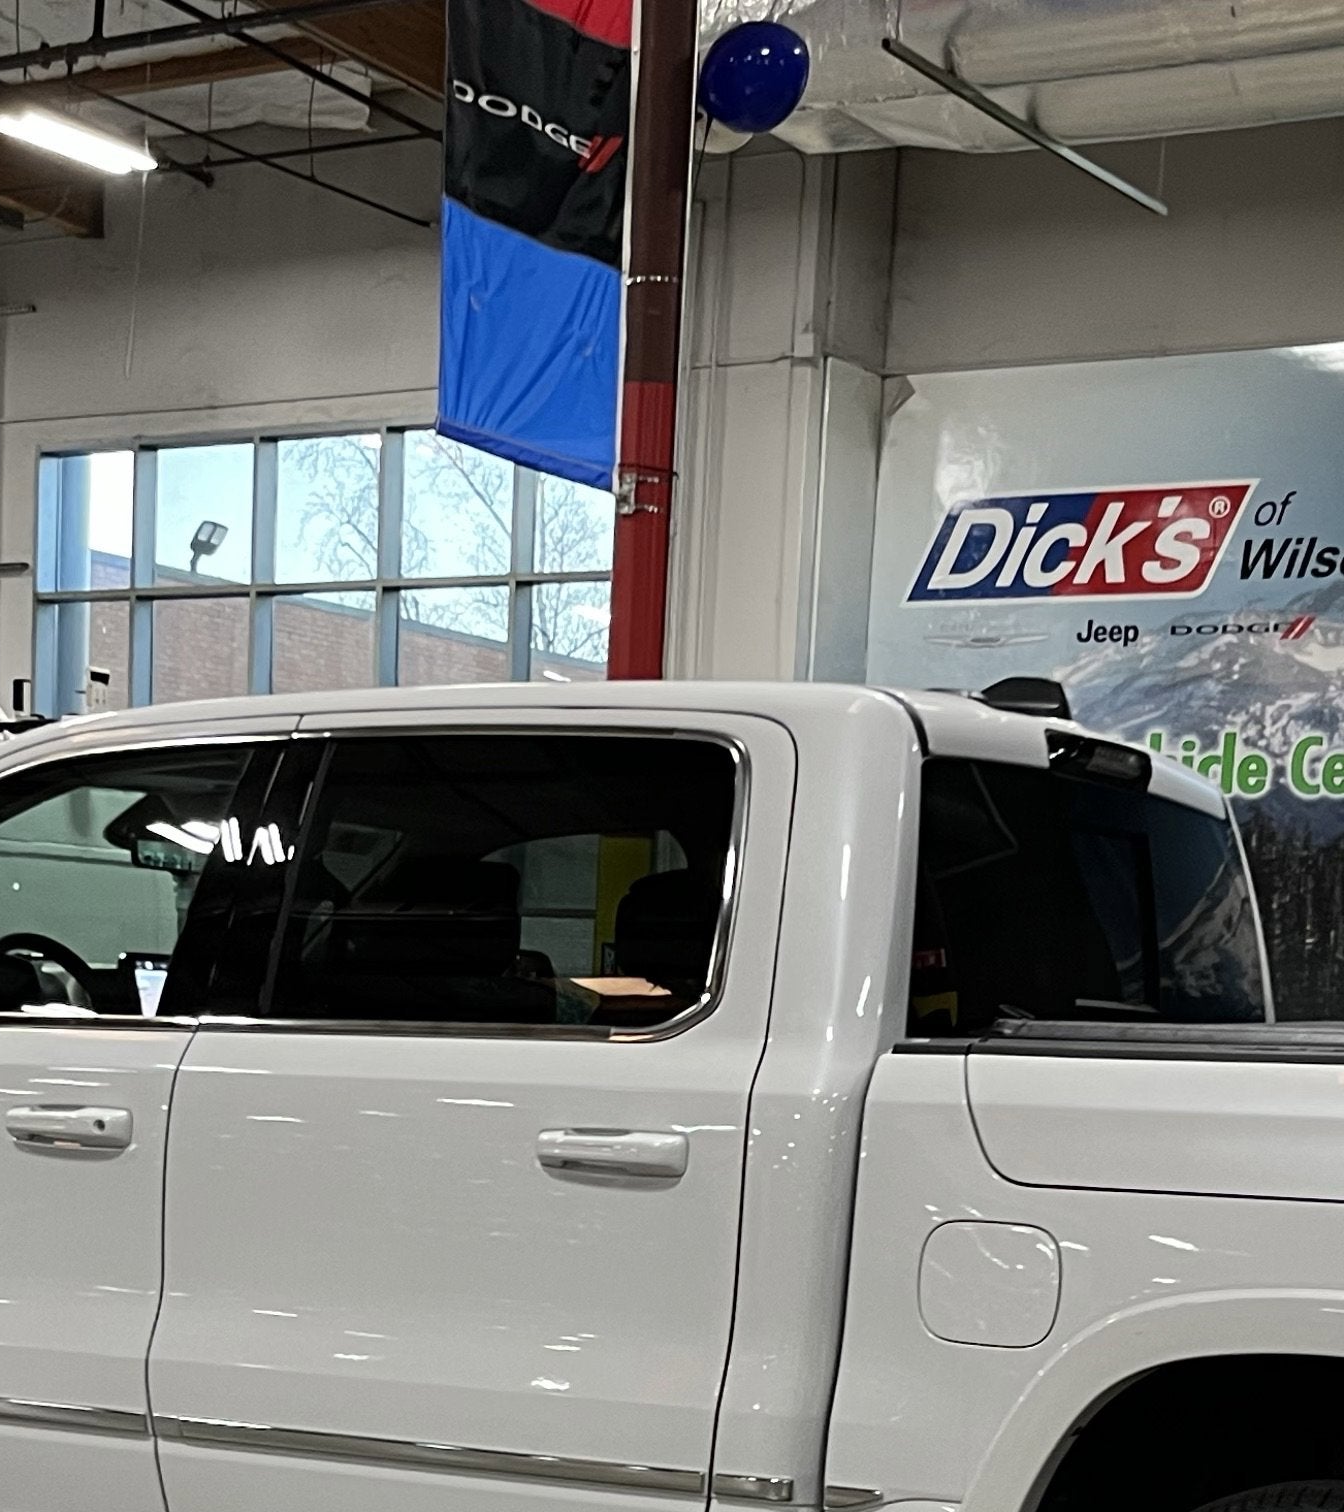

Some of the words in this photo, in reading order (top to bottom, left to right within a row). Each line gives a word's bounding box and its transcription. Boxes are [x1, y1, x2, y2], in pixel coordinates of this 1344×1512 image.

[453, 79, 593, 160] DODGE
[927, 496, 1212, 591] Dick's
[1254, 491, 1297, 526] of
[1077, 619, 1139, 647] Jeep
[1150, 732, 1269, 794] icle
